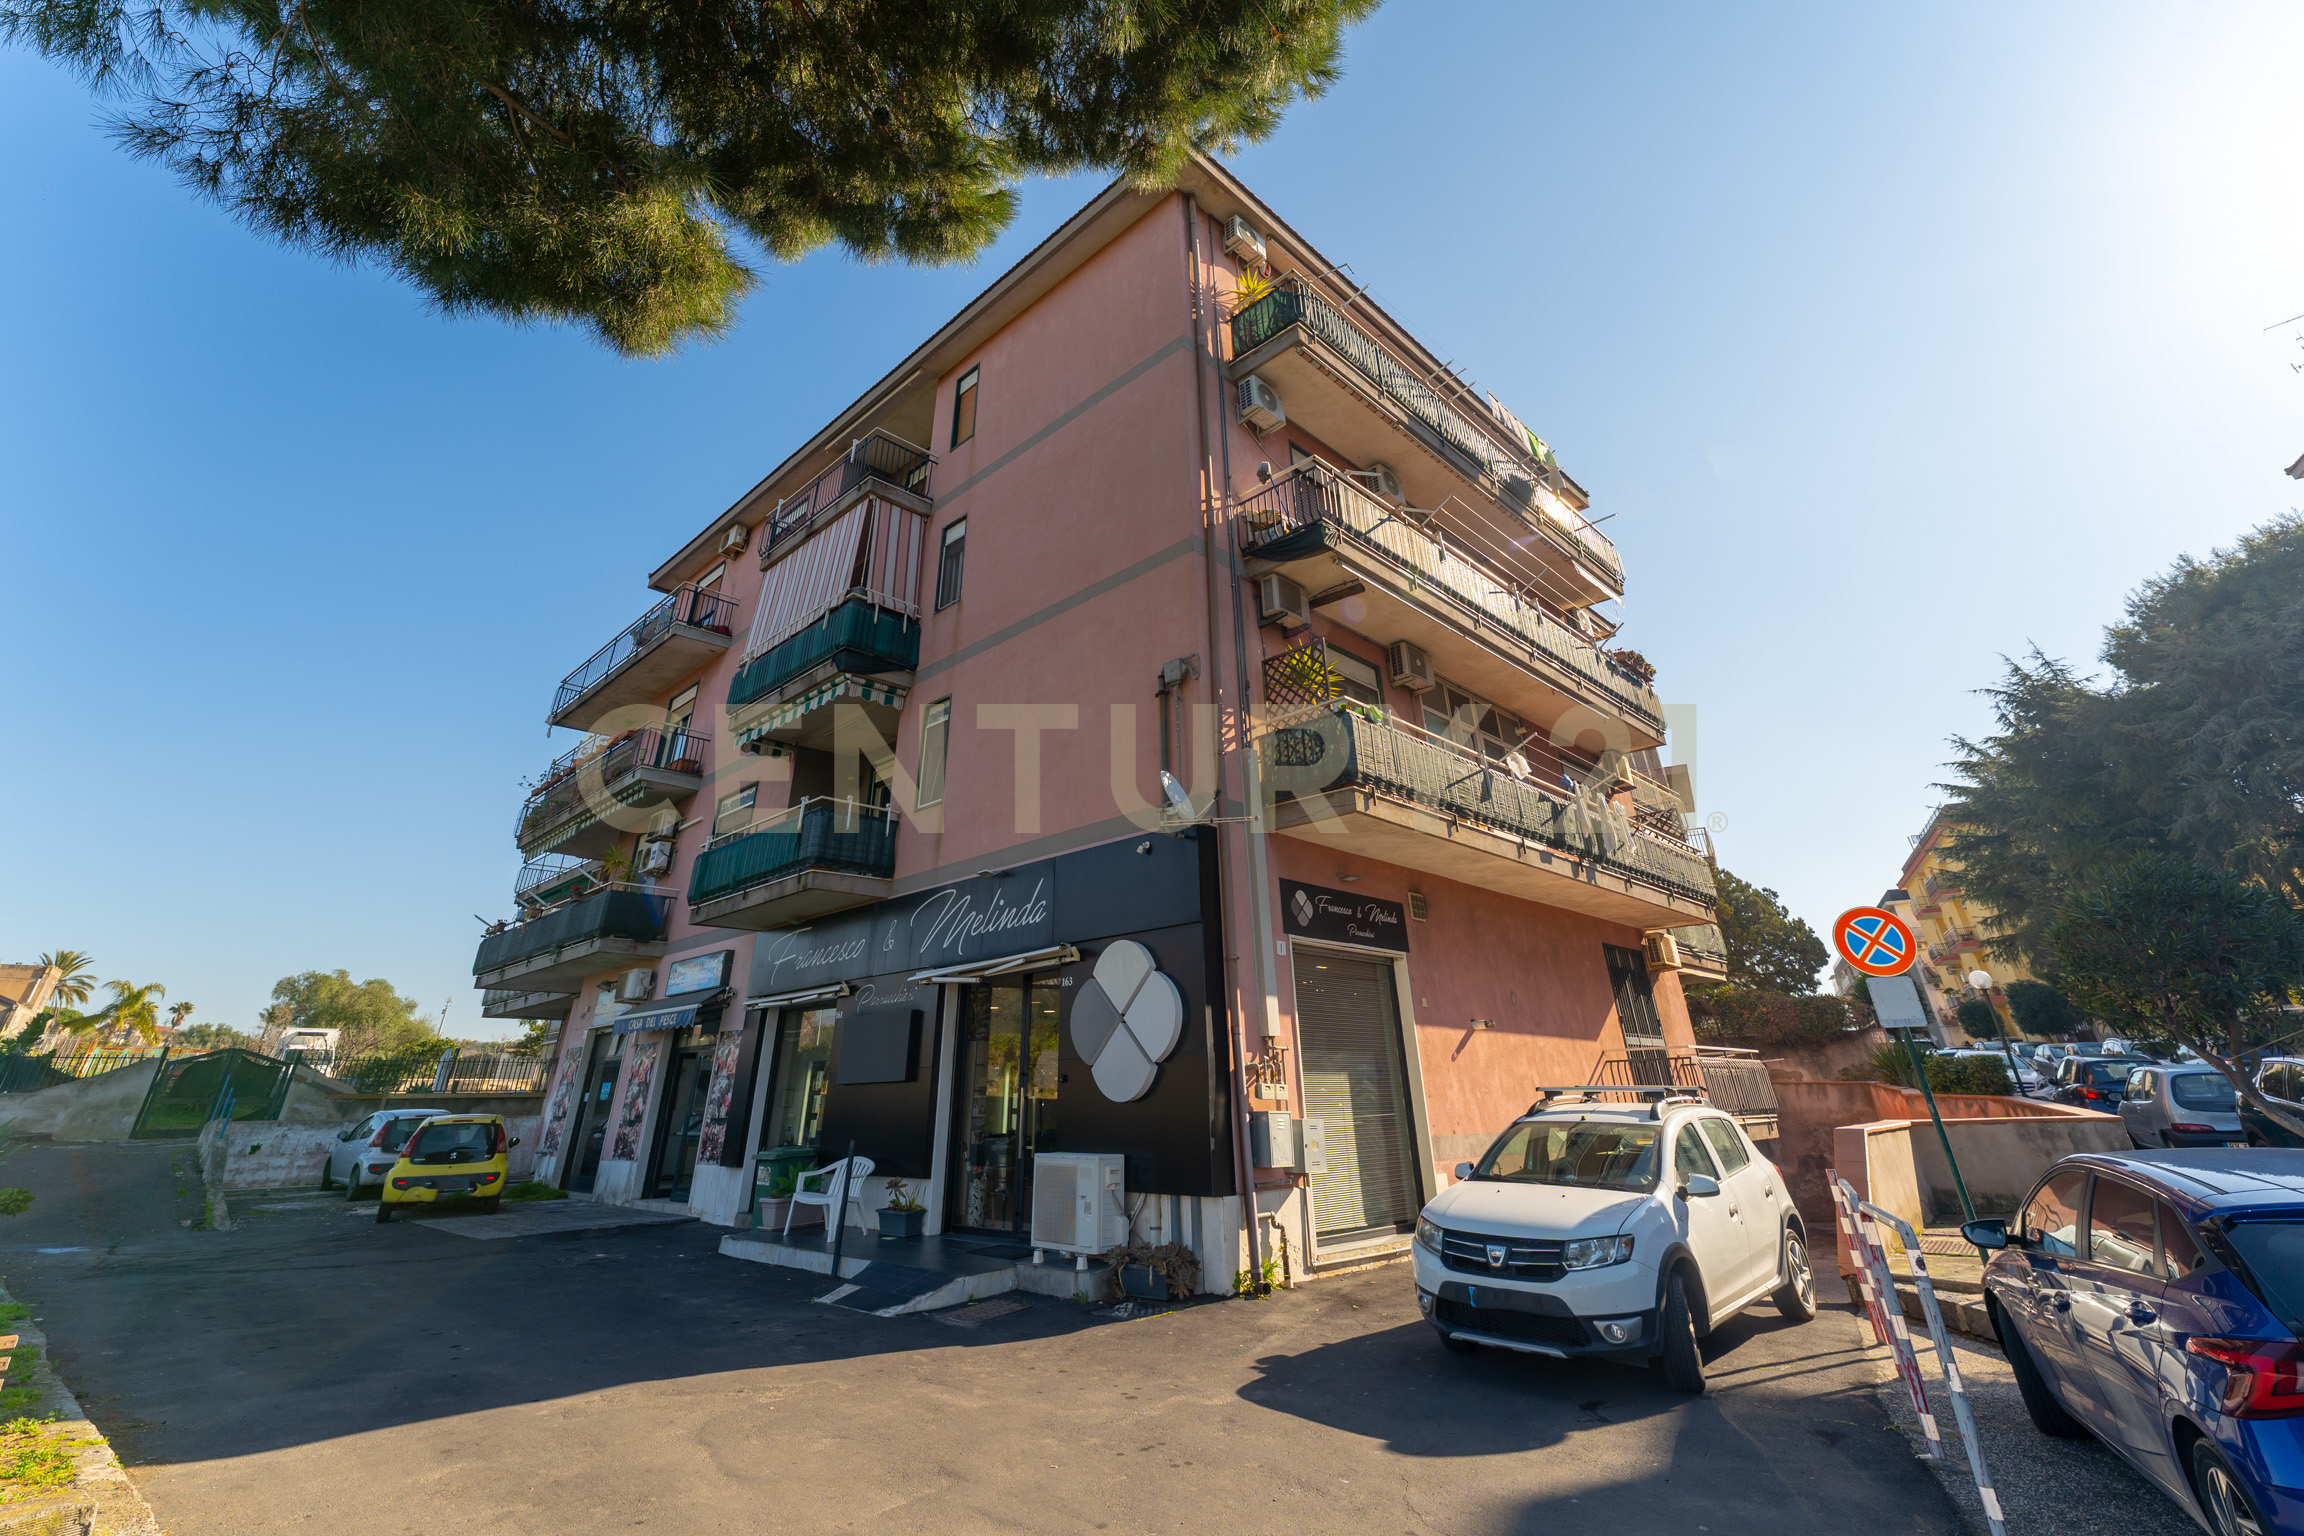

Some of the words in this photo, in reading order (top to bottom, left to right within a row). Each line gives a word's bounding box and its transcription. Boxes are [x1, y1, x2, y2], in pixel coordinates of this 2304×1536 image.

[1315, 895, 1353, 915] Francesco
[1365, 903, 1398, 925] Melinda
[768, 926, 866, 985] Francesco
[882, 919, 898, 951] &
[910, 877, 1047, 956] Melinda
[1061, 976, 1073, 987] 163
[628, 1018, 643, 1030] CASA
[659, 1013, 678, 1026] PESCE
